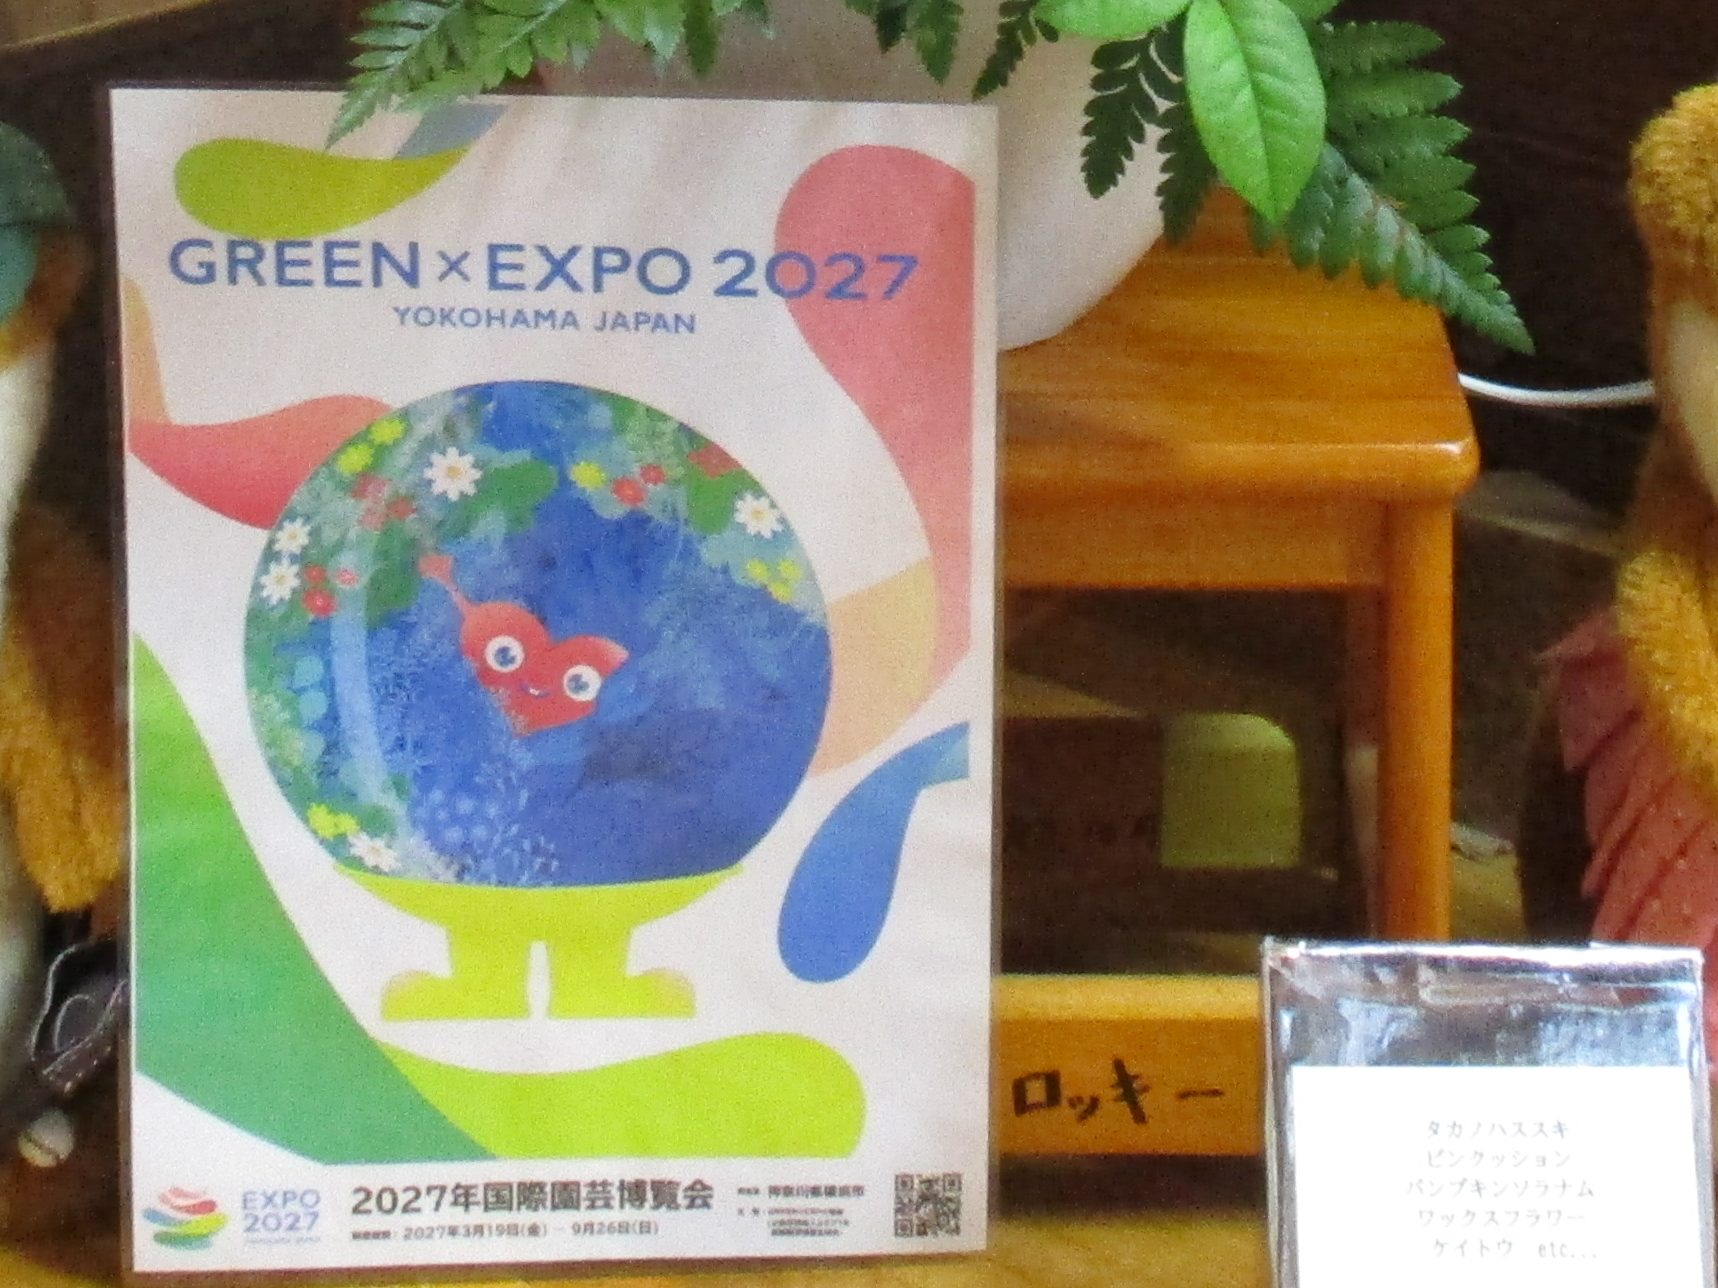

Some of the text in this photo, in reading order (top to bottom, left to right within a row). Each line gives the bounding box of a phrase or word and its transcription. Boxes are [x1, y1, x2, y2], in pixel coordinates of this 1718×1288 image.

[713, 249, 919, 302] 2027
[393, 304, 697, 336] YOKOHAMA JAPAN
[1012, 1058, 1224, 1125] ロッキー
[1427, 1119, 1568, 1139] タカノハススキ
[243, 1189, 320, 1211] EXPO
[351, 1179, 714, 1215] 2027年国際園芸博覧会
[244, 1211, 320, 1234] 2027
[1434, 1238, 1512, 1258] ケイトウ
